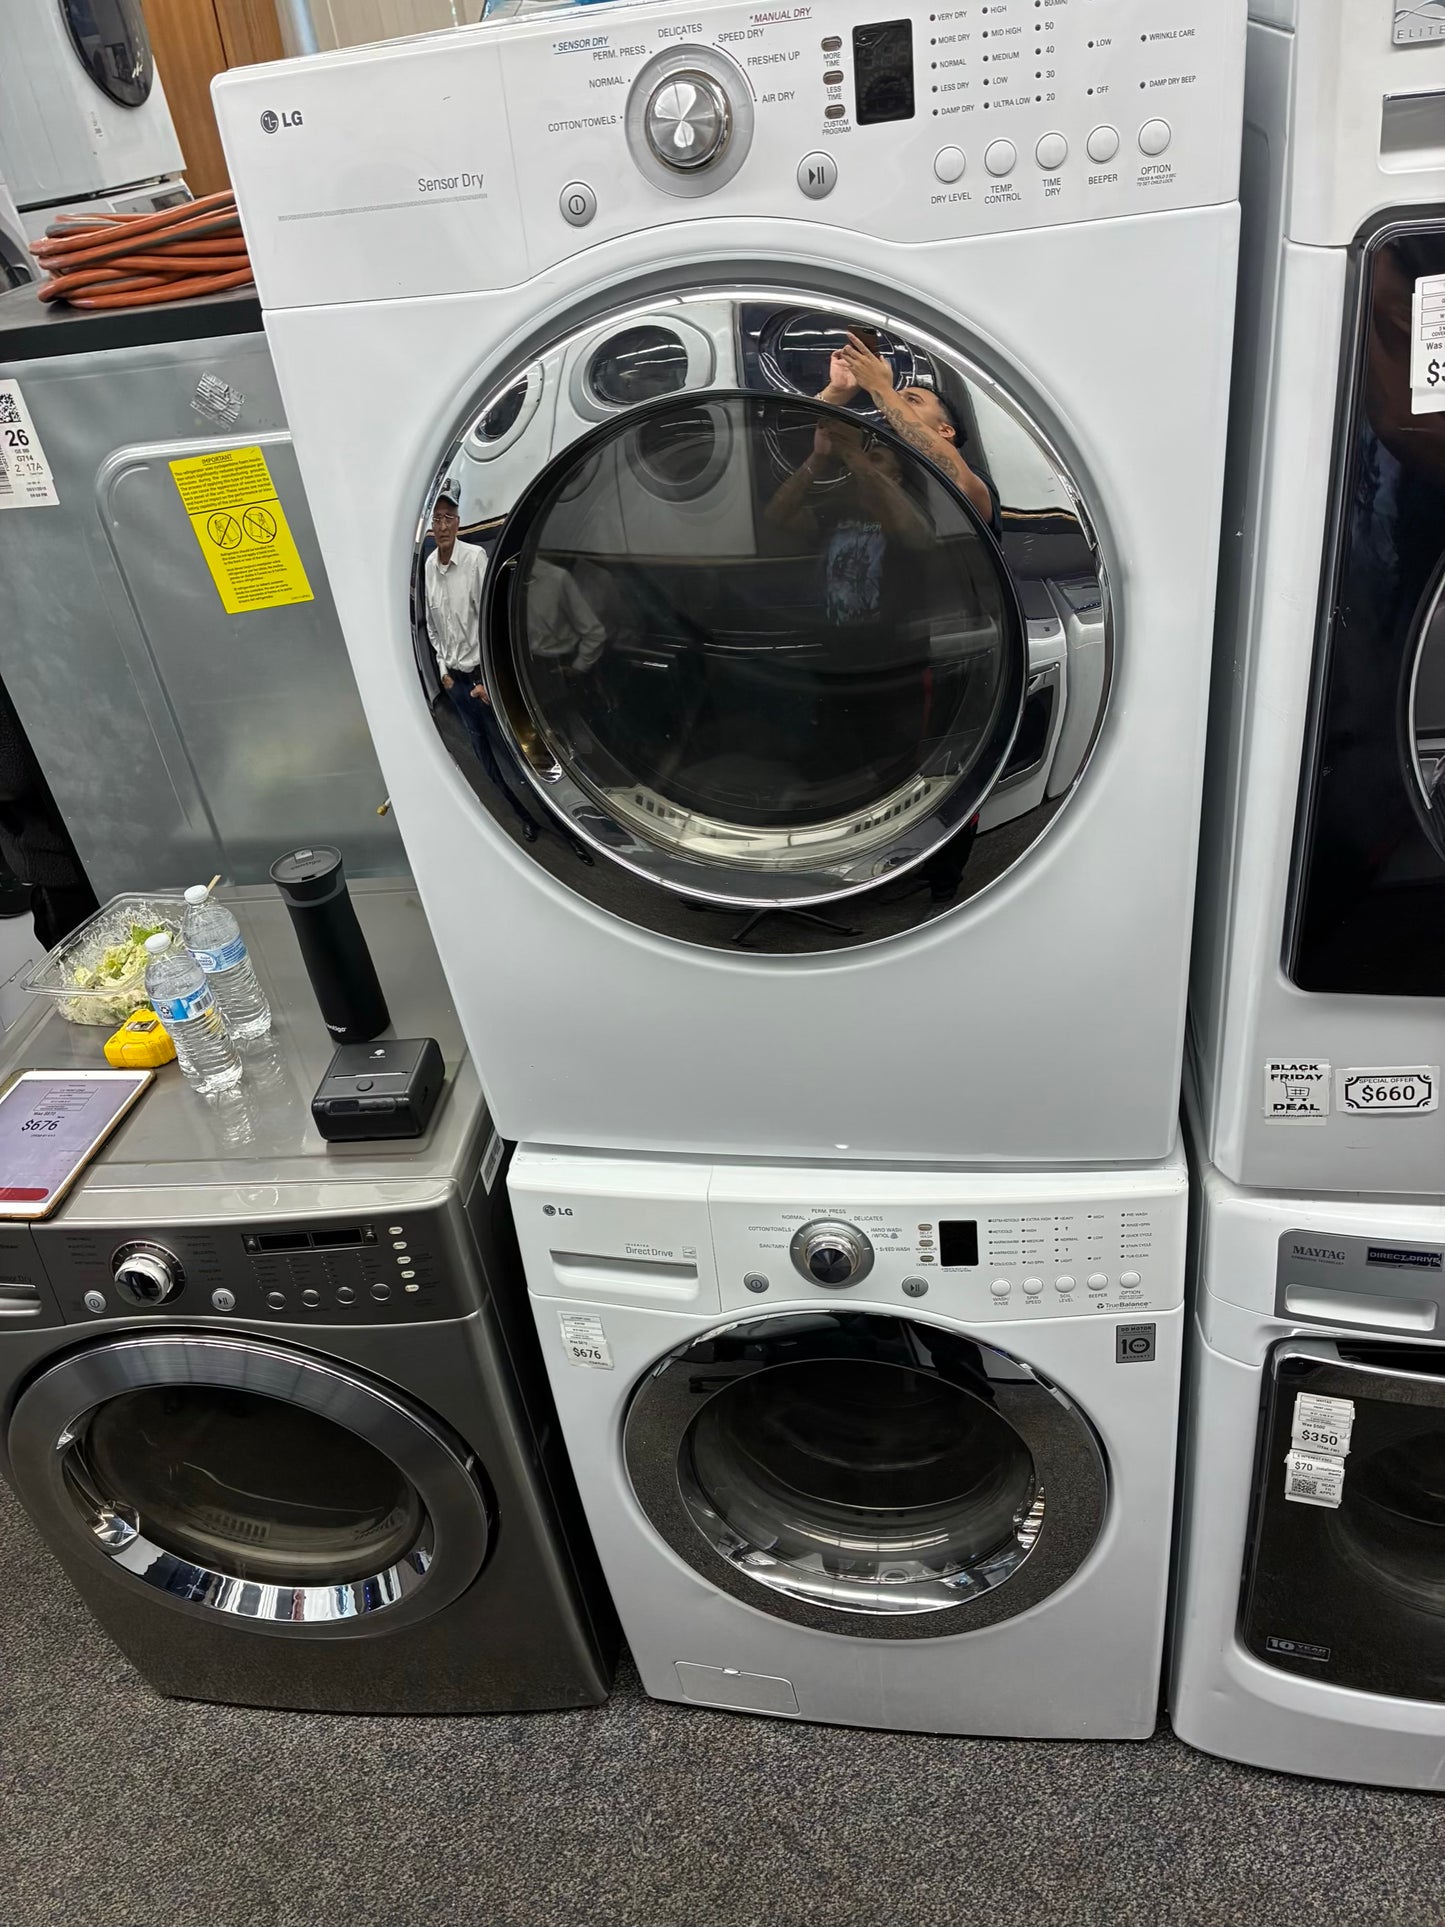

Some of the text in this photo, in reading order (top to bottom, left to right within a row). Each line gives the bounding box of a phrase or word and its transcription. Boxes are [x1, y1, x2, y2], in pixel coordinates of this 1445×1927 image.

[791, 7, 812, 20] DRY
[990, 5, 1007, 14] HIGH
[937, 11, 967, 21] VERY DRY
[657, 23, 703, 38] DELICATES
[1045, 22, 1054, 30] 50
[718, 29, 765, 43] SPEED DRY
[991, 27, 1022, 37] MID HIGH
[1149, 29, 1196, 41] WRINKLE CARE
[588, 36, 609, 48] DRY
[938, 34, 970, 44] MORE DRY
[1096, 39, 1112, 47] LOW
[592, 46, 646, 62] PERM. PRESS
[1046, 46, 1055, 54] 40
[747, 51, 801, 67] FRESHEN UP
[823, 52, 841, 60] MORE
[991, 52, 1020, 62] MEDIUM
[825, 59, 840, 67] TIME
[939, 59, 967, 69] NORMAL
[1046, 70, 1055, 78] 30
[589, 77, 625, 89] NORMAL
[993, 76, 1008, 85] LOW
[1149, 75, 1196, 88] DAMP DRY BEEP
[826, 86, 842, 95] LESS
[940, 82, 970, 92] LESS DRY
[1096, 86, 1110, 94] OFF
[762, 91, 795, 103] AIR DRY
[827, 93, 842, 101] TIME
[1046, 93, 1056, 101] 20
[993, 96, 1031, 109] ULTRA LOW
[941, 104, 975, 116] DAMP DRY
[281, 110, 303, 128] LG
[548, 115, 617, 132] COTTON/TOWELS
[823, 119, 849, 128] CUSTOM
[822, 126, 852, 136] PROGRAM
[1140, 164, 1172, 175] OPTION
[418, 172, 484, 192] Sensor Dry
[1042, 177, 1062, 187] TIME
[1088, 173, 1118, 185] BEEPER
[990, 184, 1013, 194] TEMP.
[1044, 187, 1061, 197] DRY
[930, 192, 972, 205] DRY LEVEL
[984, 193, 1022, 205] CONTROL
[1426, 342, 1443, 351] Was
[5, 429, 29, 447] 26
[201, 453, 232, 465] IMPORTANT
[15, 463, 43, 473] 2 17A
[1270, 1064, 1319, 1072] BLACK
[1361, 1085, 1415, 1103] $660
[1273, 1103, 1320, 1111] DEAL
[21, 1119, 59, 1132] $676
[557, 1207, 574, 1217] LG
[625, 1246, 674, 1258] Direct Drive
[1293, 1245, 1346, 1260] MAYTAG
[572, 1347, 601, 1360] $676
[1301, 1429, 1338, 1446] $350
[1294, 1461, 1313, 1471] $70
[1270, 1639, 1295, 1651] 10
